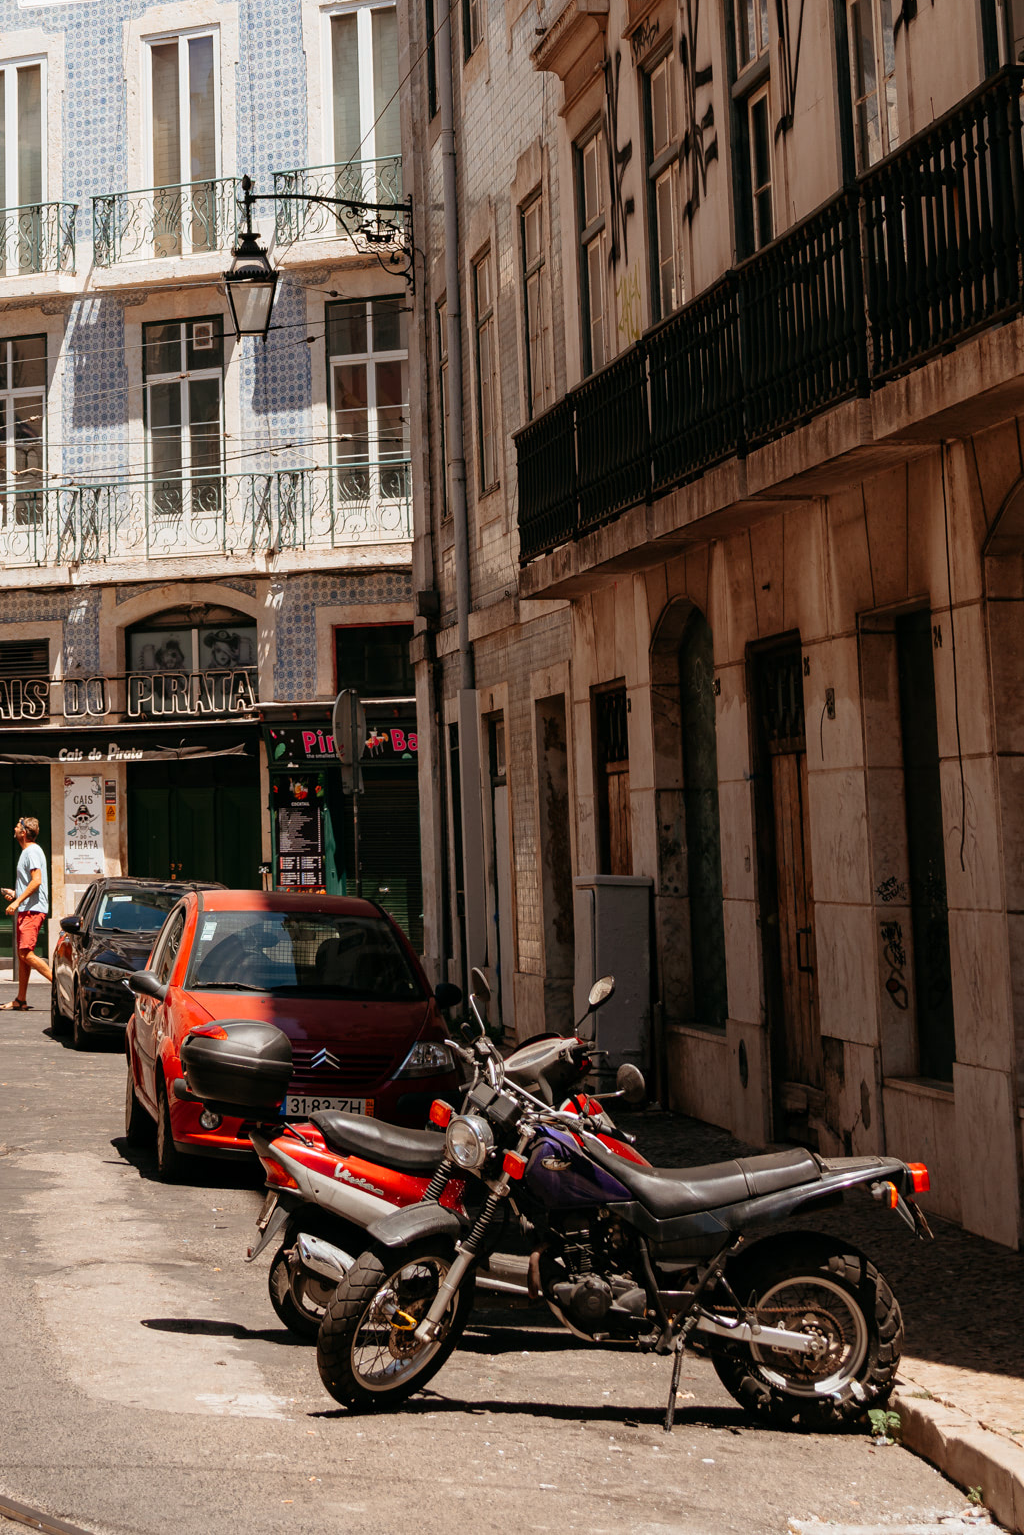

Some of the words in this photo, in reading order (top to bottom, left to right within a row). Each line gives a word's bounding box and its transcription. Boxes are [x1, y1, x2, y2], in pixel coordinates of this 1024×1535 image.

[63, 676, 111, 718] DO
[128, 671, 255, 716] PIRATA
[389, 728, 418, 751] Ba
[59, 748, 83, 762] Cais
[88, 747, 102, 761] do
[107, 742, 144, 761] Pirata
[73, 795, 93, 805] CAIS
[69, 840, 99, 850] PIRATA
